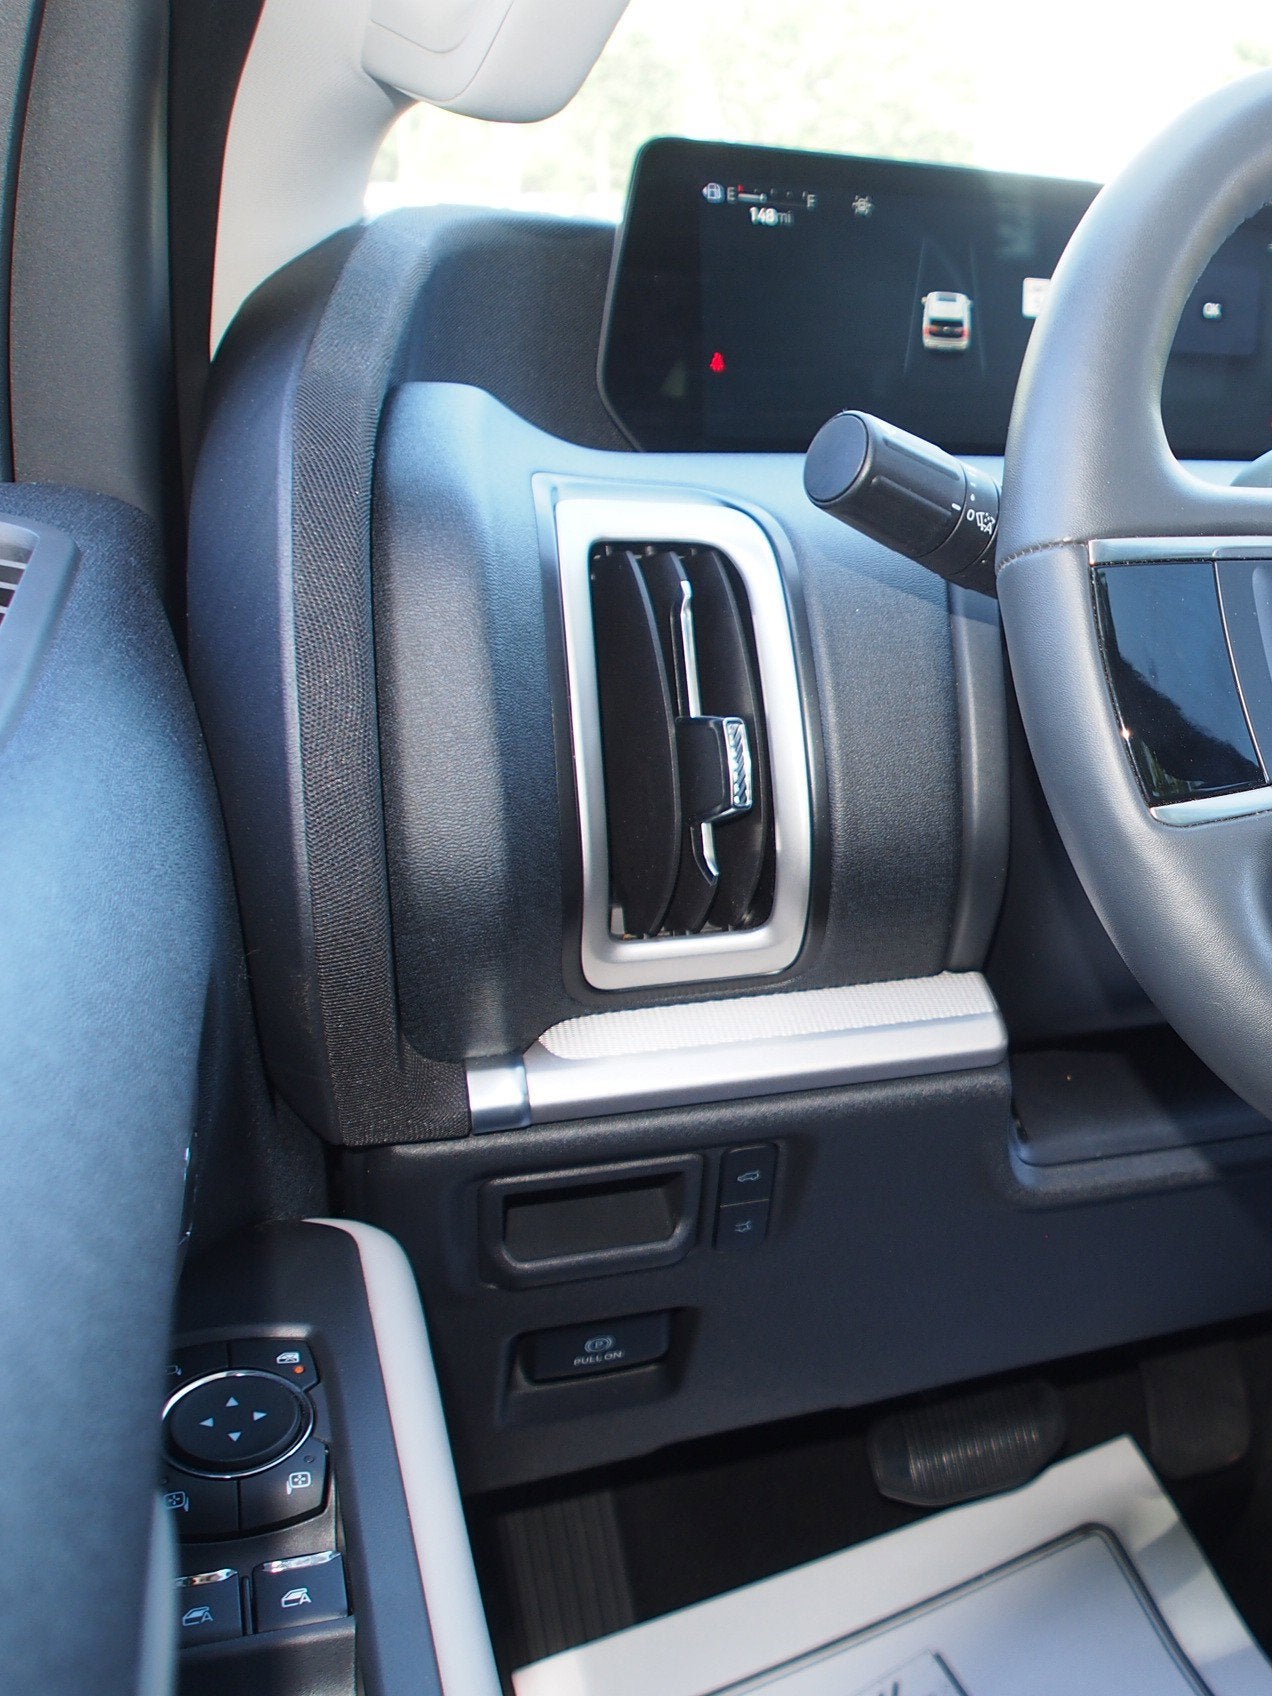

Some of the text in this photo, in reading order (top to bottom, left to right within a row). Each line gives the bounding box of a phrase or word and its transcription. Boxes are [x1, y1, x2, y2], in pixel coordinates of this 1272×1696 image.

[726, 186, 738, 202] E
[573, 1350, 622, 1366] PULL ON
